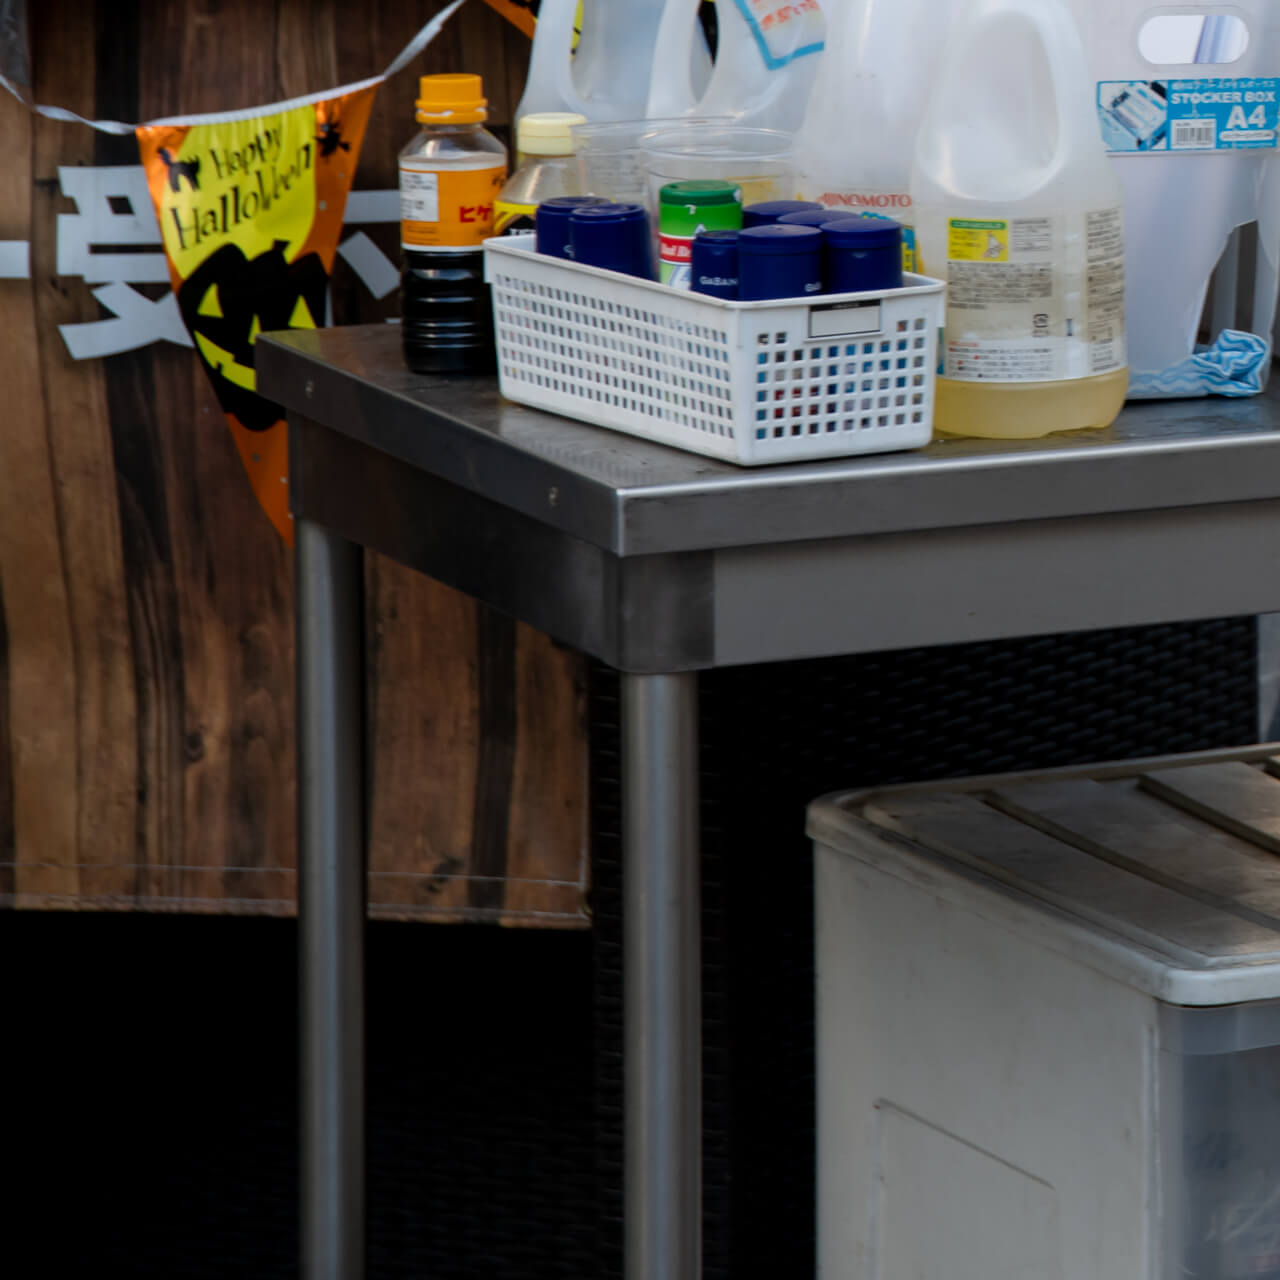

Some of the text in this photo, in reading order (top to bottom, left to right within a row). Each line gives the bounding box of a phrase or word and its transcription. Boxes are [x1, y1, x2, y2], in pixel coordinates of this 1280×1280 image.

[1170, 91, 1276, 105] STOCKER BOX
[1225, 104, 1267, 129] A4
[209, 128, 281, 180] Happy
